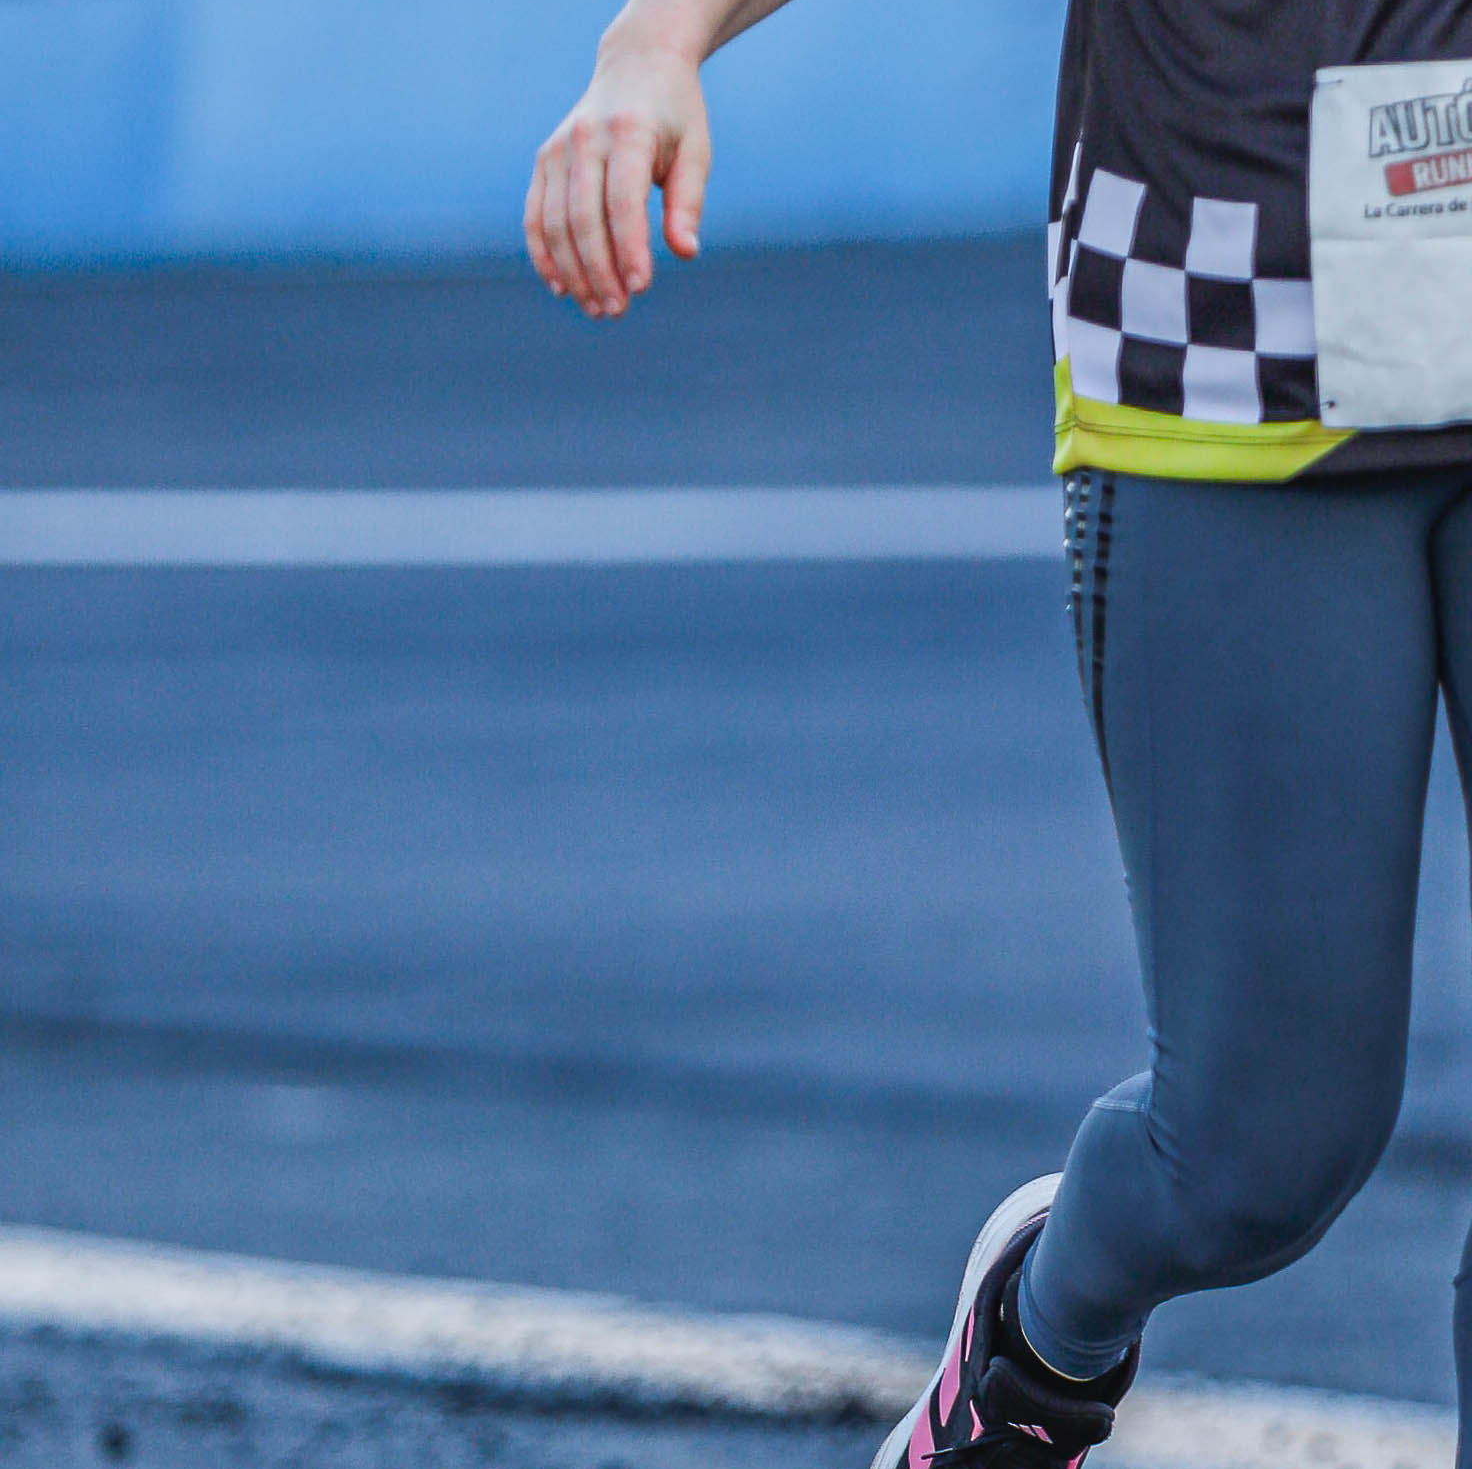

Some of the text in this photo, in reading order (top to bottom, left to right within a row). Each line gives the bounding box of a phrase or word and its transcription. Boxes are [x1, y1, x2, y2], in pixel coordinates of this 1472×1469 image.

[1364, 203, 1382, 219] La
[1386, 202, 1444, 218] Carrera
[1449, 197, 1467, 212] de
